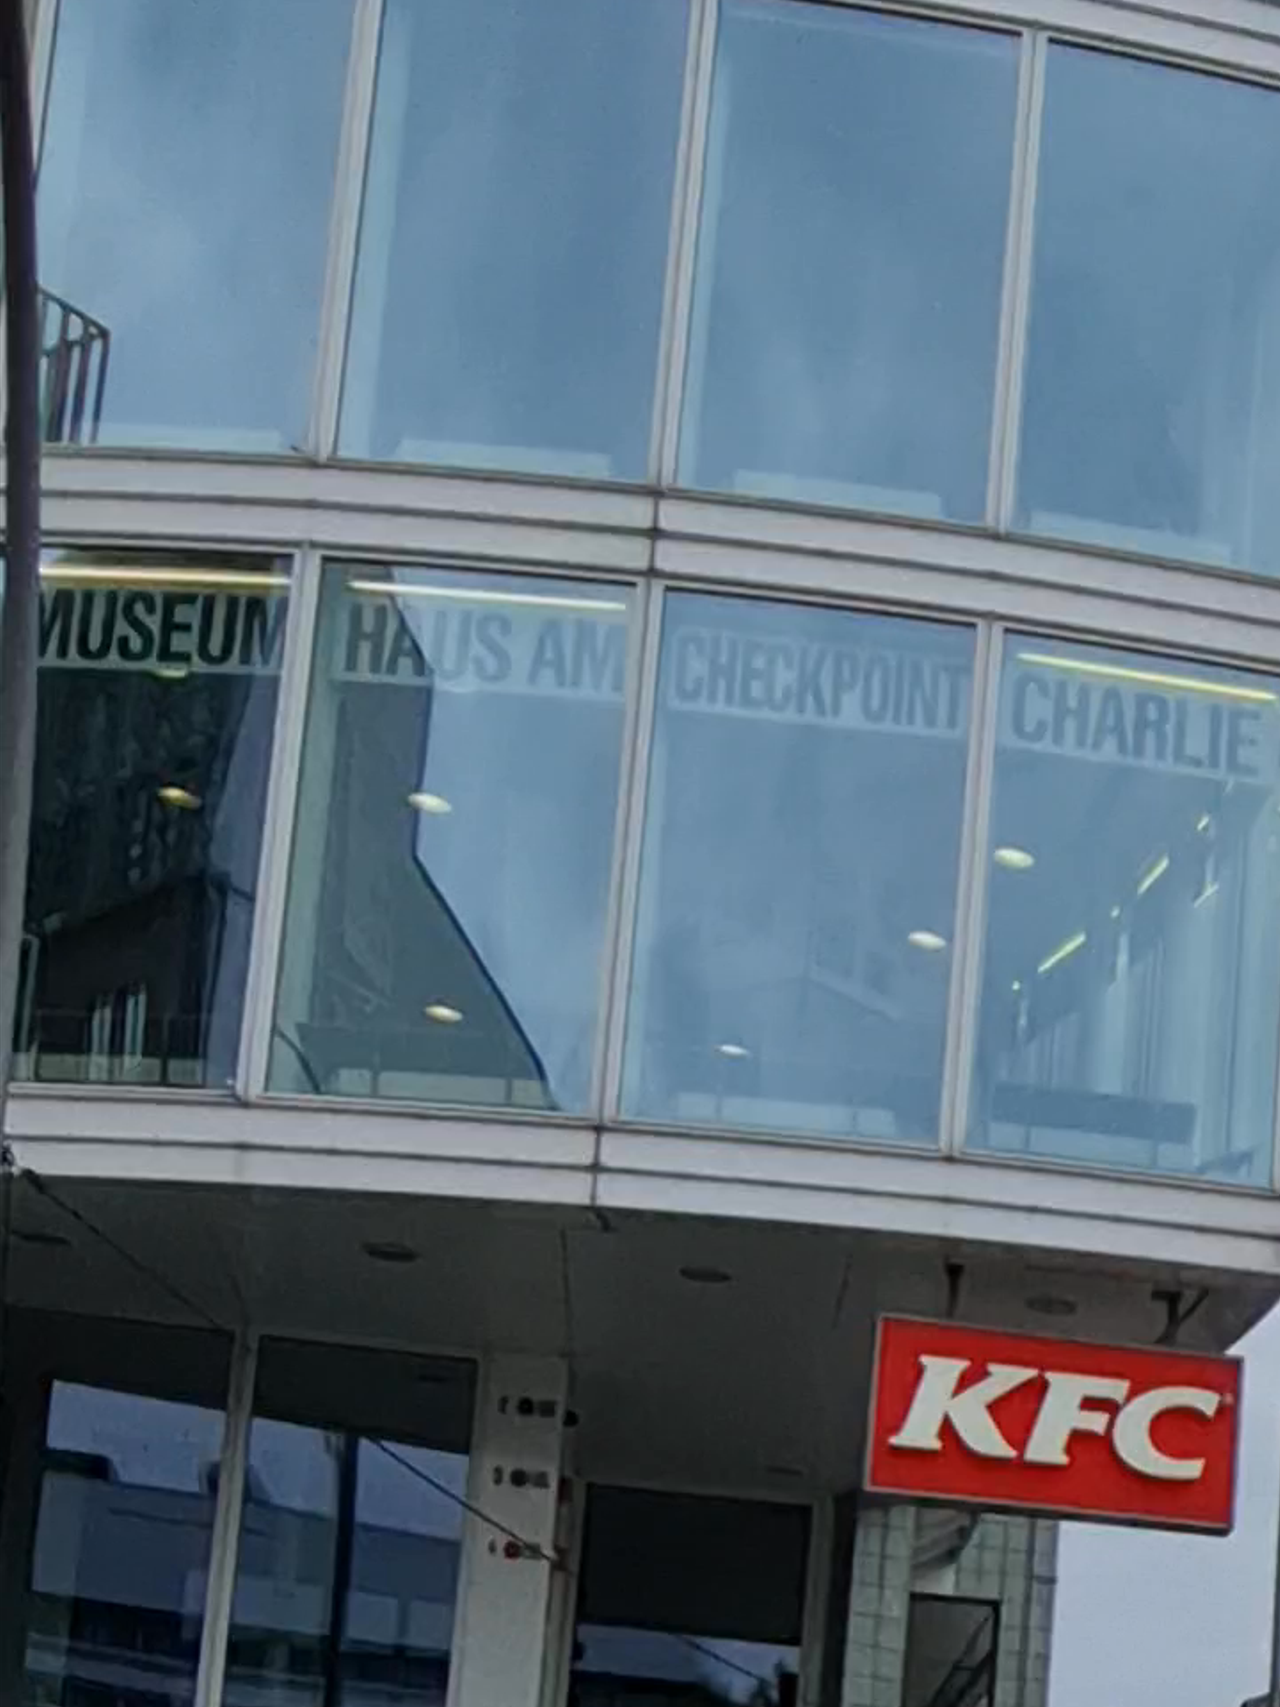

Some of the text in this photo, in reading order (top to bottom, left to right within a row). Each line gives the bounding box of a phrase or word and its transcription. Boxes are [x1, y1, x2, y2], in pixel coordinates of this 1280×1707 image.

[38, 588, 1262, 775] MUSEUM HAUS AM CHECKPOINT CHARLIE
[888, 1354, 1221, 1481] KFC
